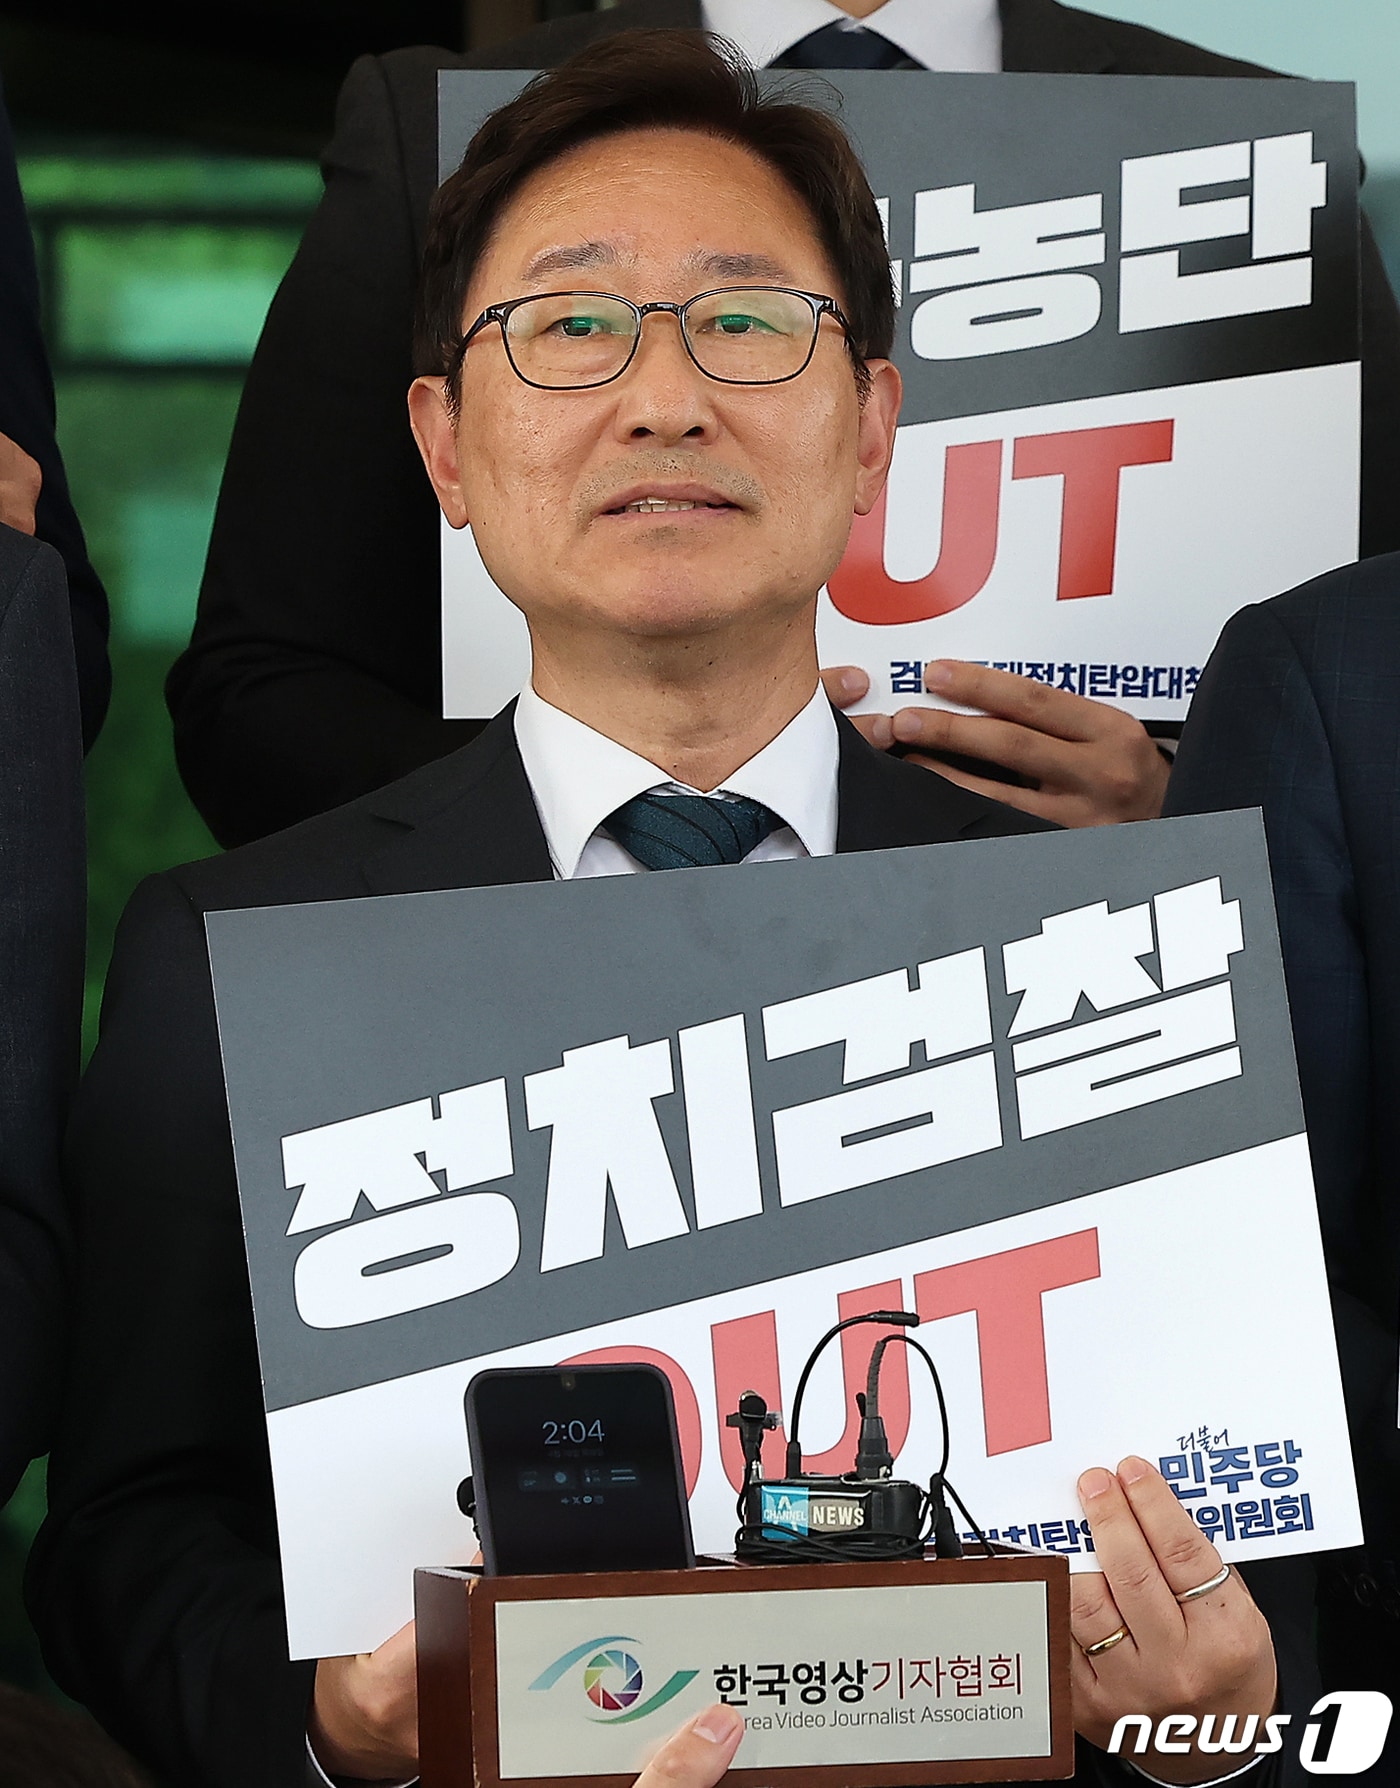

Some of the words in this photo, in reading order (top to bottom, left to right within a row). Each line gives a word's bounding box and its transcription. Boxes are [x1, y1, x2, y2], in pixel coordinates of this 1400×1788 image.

[874, 131, 1327, 361] 농단
[826, 418, 1175, 626] UT
[280, 876, 1244, 1330] 정치검찰
[542, 1419, 605, 1444] 2:04
[1176, 1425, 1230, 1453] 더불어
[1159, 1439, 1302, 1500] 민주당
[763, 1509, 806, 1521] CHANNEL
[812, 1505, 865, 1526] NEWS
[713, 1652, 1022, 1707] 한국영상기자협회
[744, 1712, 772, 1731] rea
[776, 1707, 826, 1728] Video
[829, 1704, 915, 1727] Journalist
[920, 1703, 1023, 1723] Association
